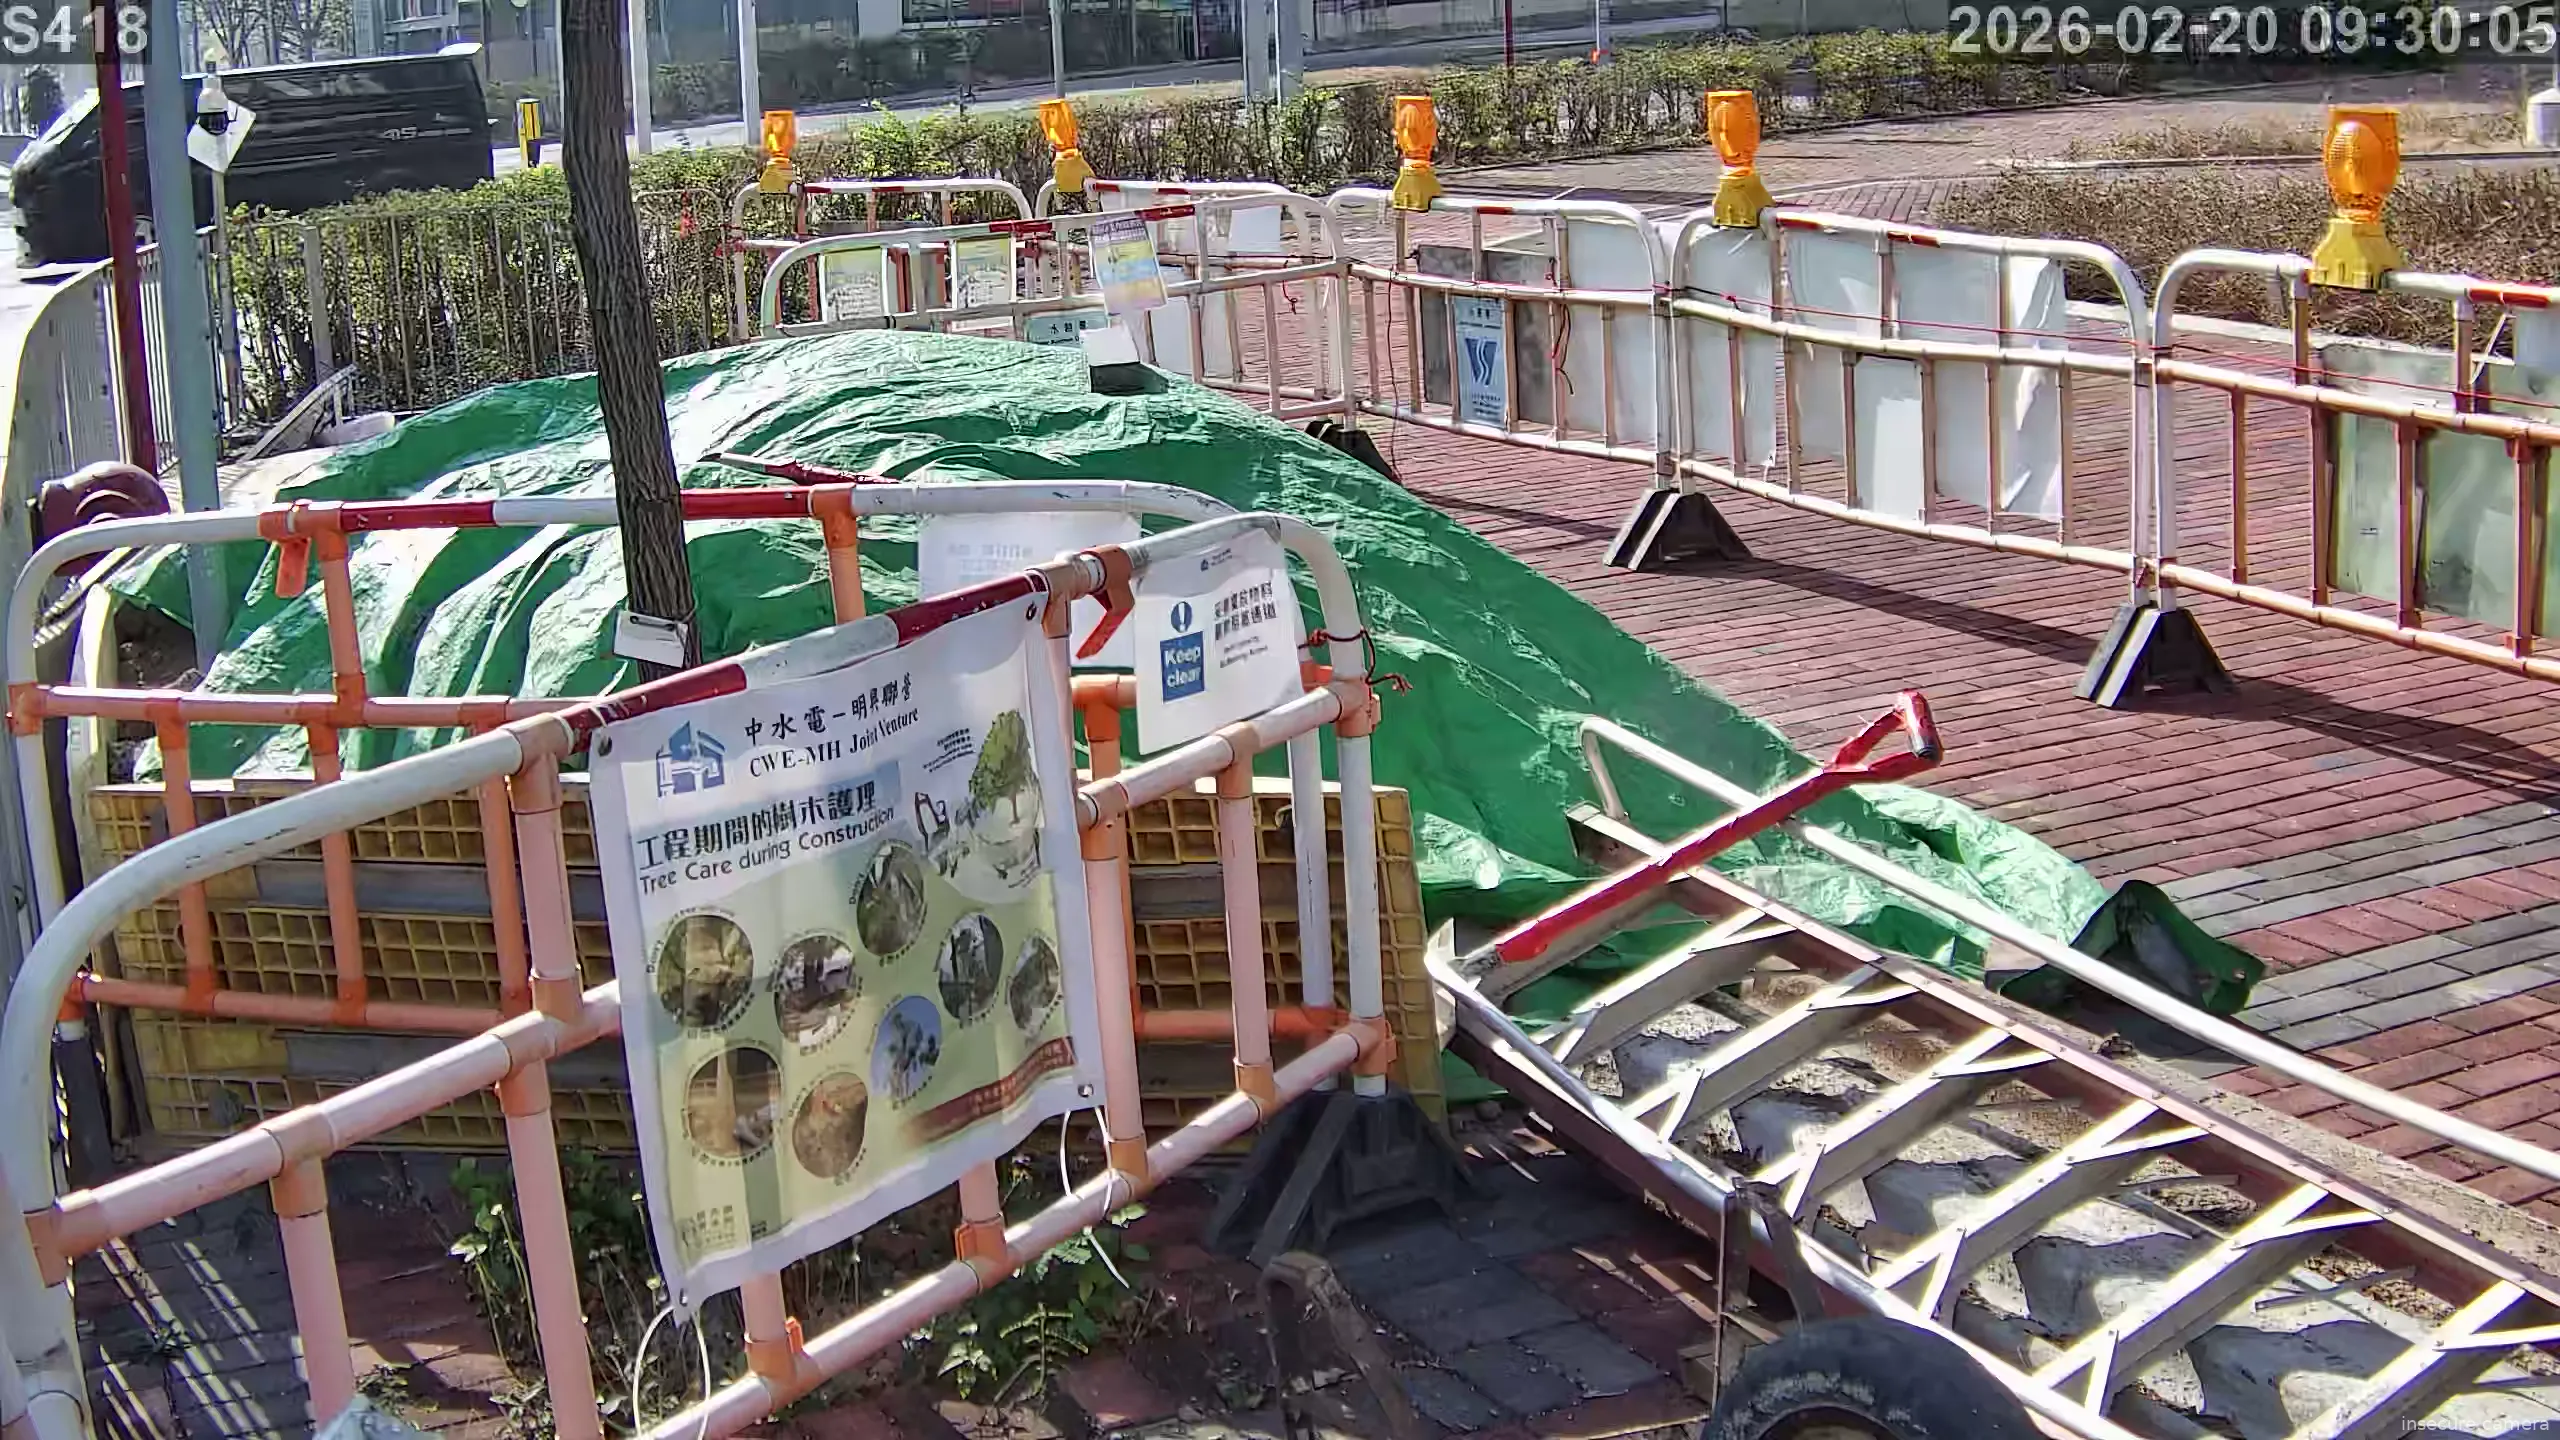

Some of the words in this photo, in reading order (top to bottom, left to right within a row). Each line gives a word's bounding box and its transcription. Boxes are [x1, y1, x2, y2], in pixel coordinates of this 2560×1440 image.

[1165, 645, 1202, 665] Keep
[1166, 668, 1201, 688] clear
[750, 740, 841, 778] CWE-MH
[849, 727, 879, 754] Joint
[878, 708, 920, 739] Venture
[637, 780, 876, 871] 工程期間的樹木護理
[639, 869, 677, 895] Tree
[685, 859, 733, 881] Care
[739, 839, 791, 870] during
[799, 806, 895, 851] Construction
